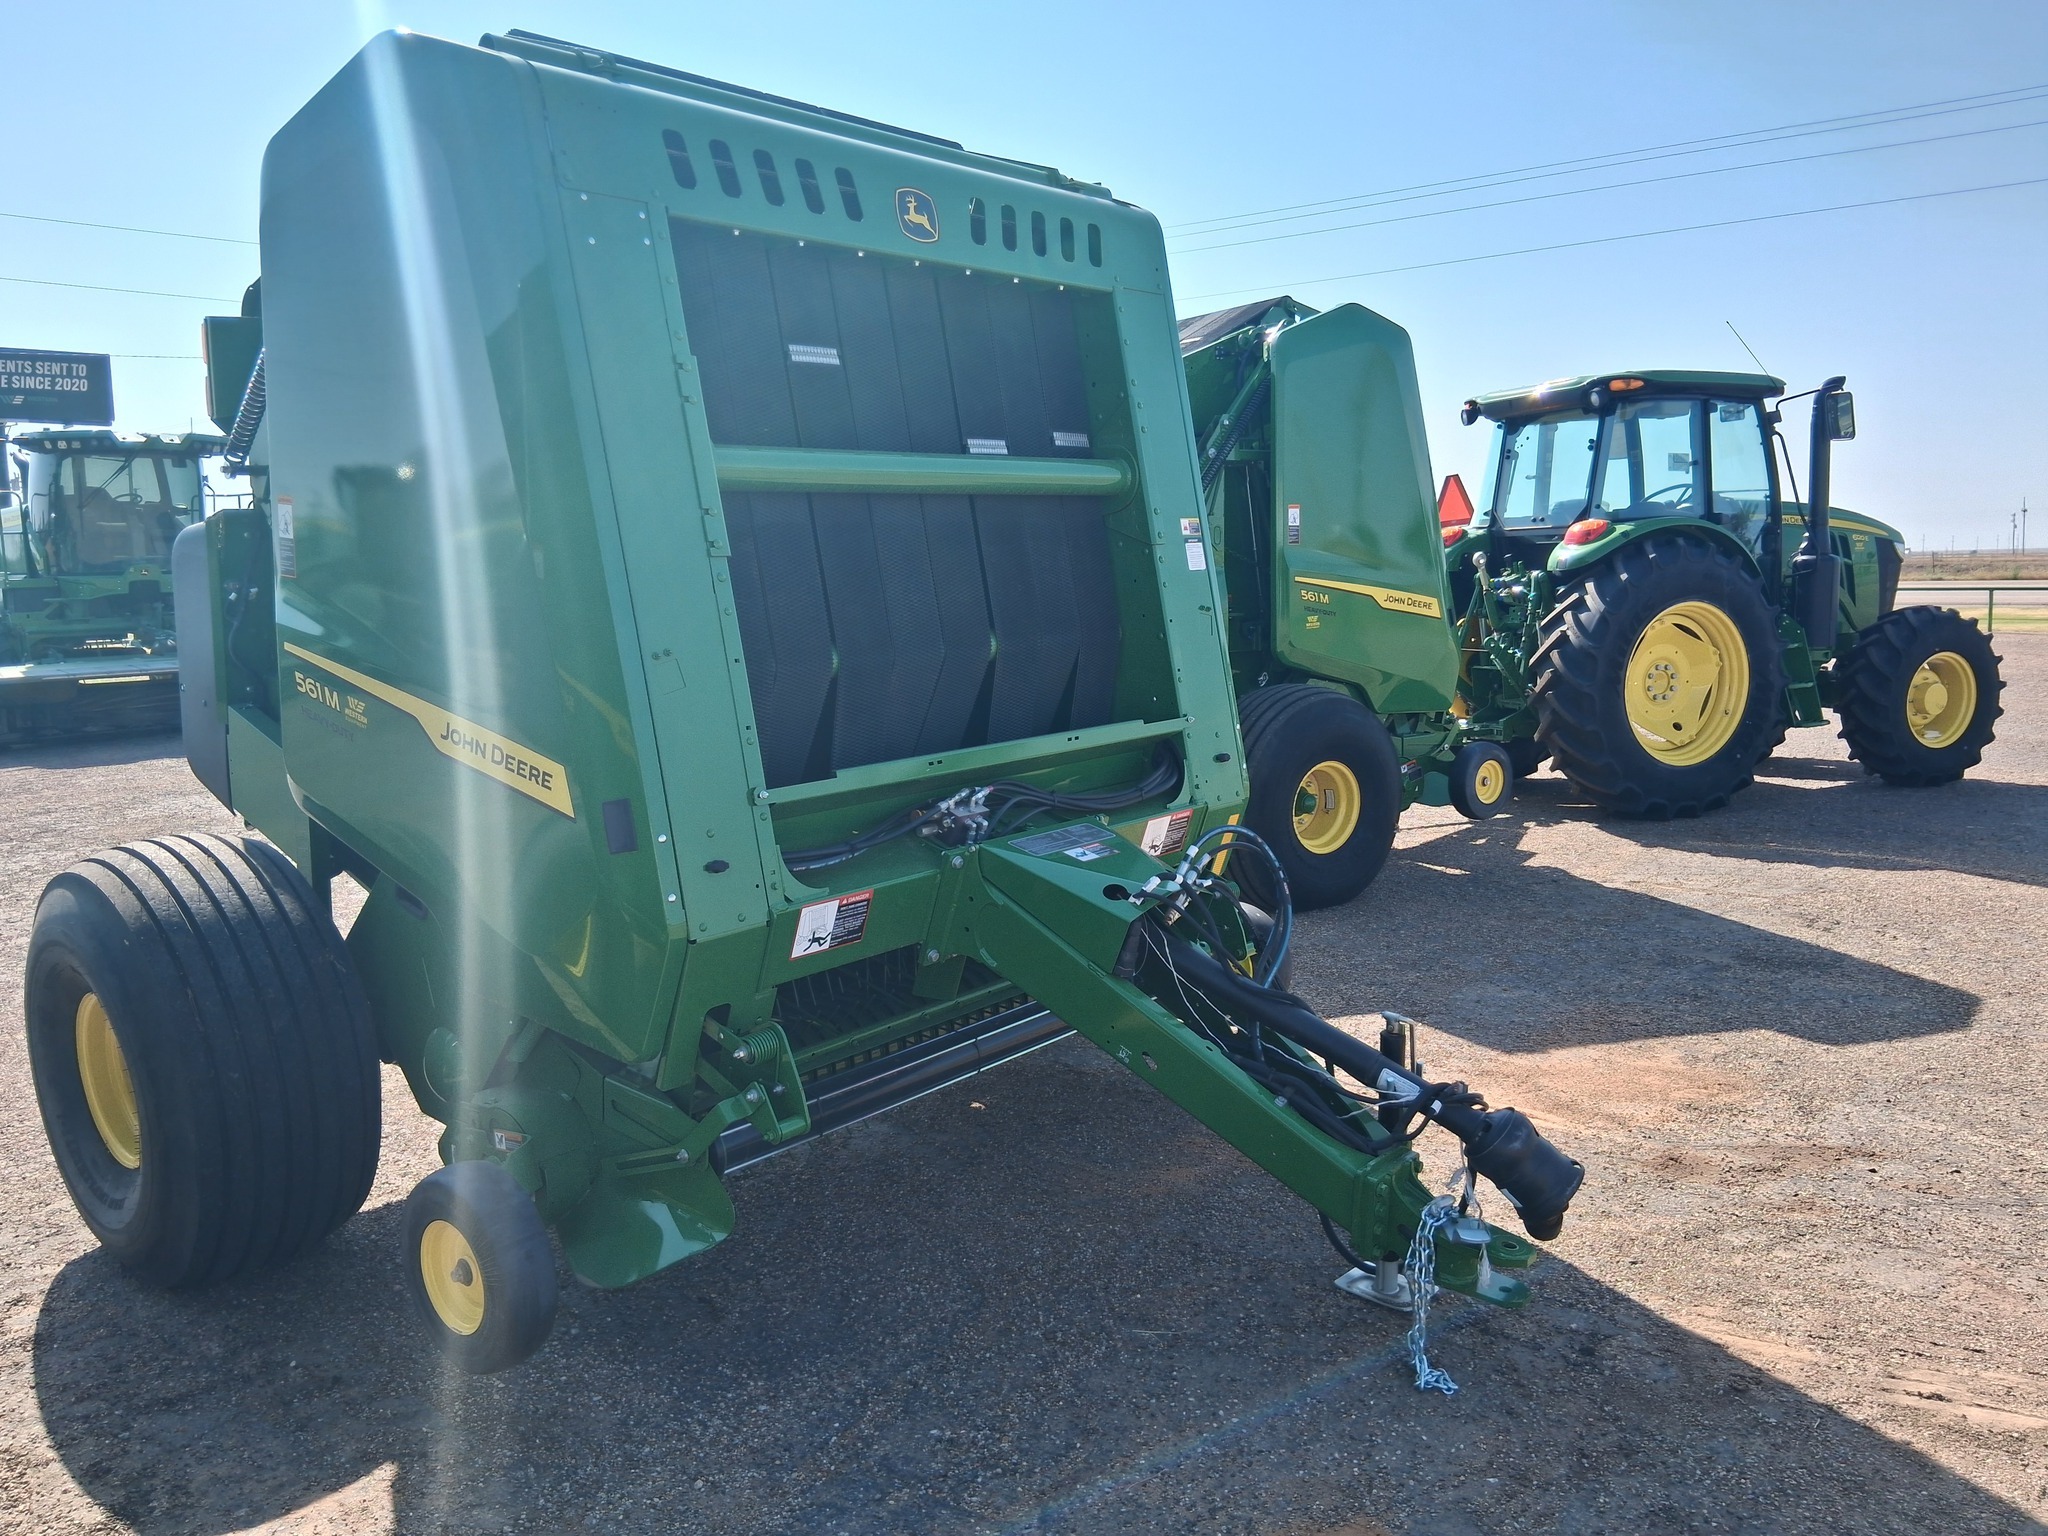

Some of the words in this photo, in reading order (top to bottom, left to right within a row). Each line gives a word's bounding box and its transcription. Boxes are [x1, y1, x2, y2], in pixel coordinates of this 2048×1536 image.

[35, 361, 69, 376] SENT
[71, 363, 87, 377] TO
[11, 375, 52, 390] SINCE
[54, 378, 88, 392] 2020
[1383, 593, 1406, 605] JOHN
[1406, 597, 1433, 611] DEERE
[440, 722, 487, 760] JOHN
[490, 743, 554, 792] DEERE
